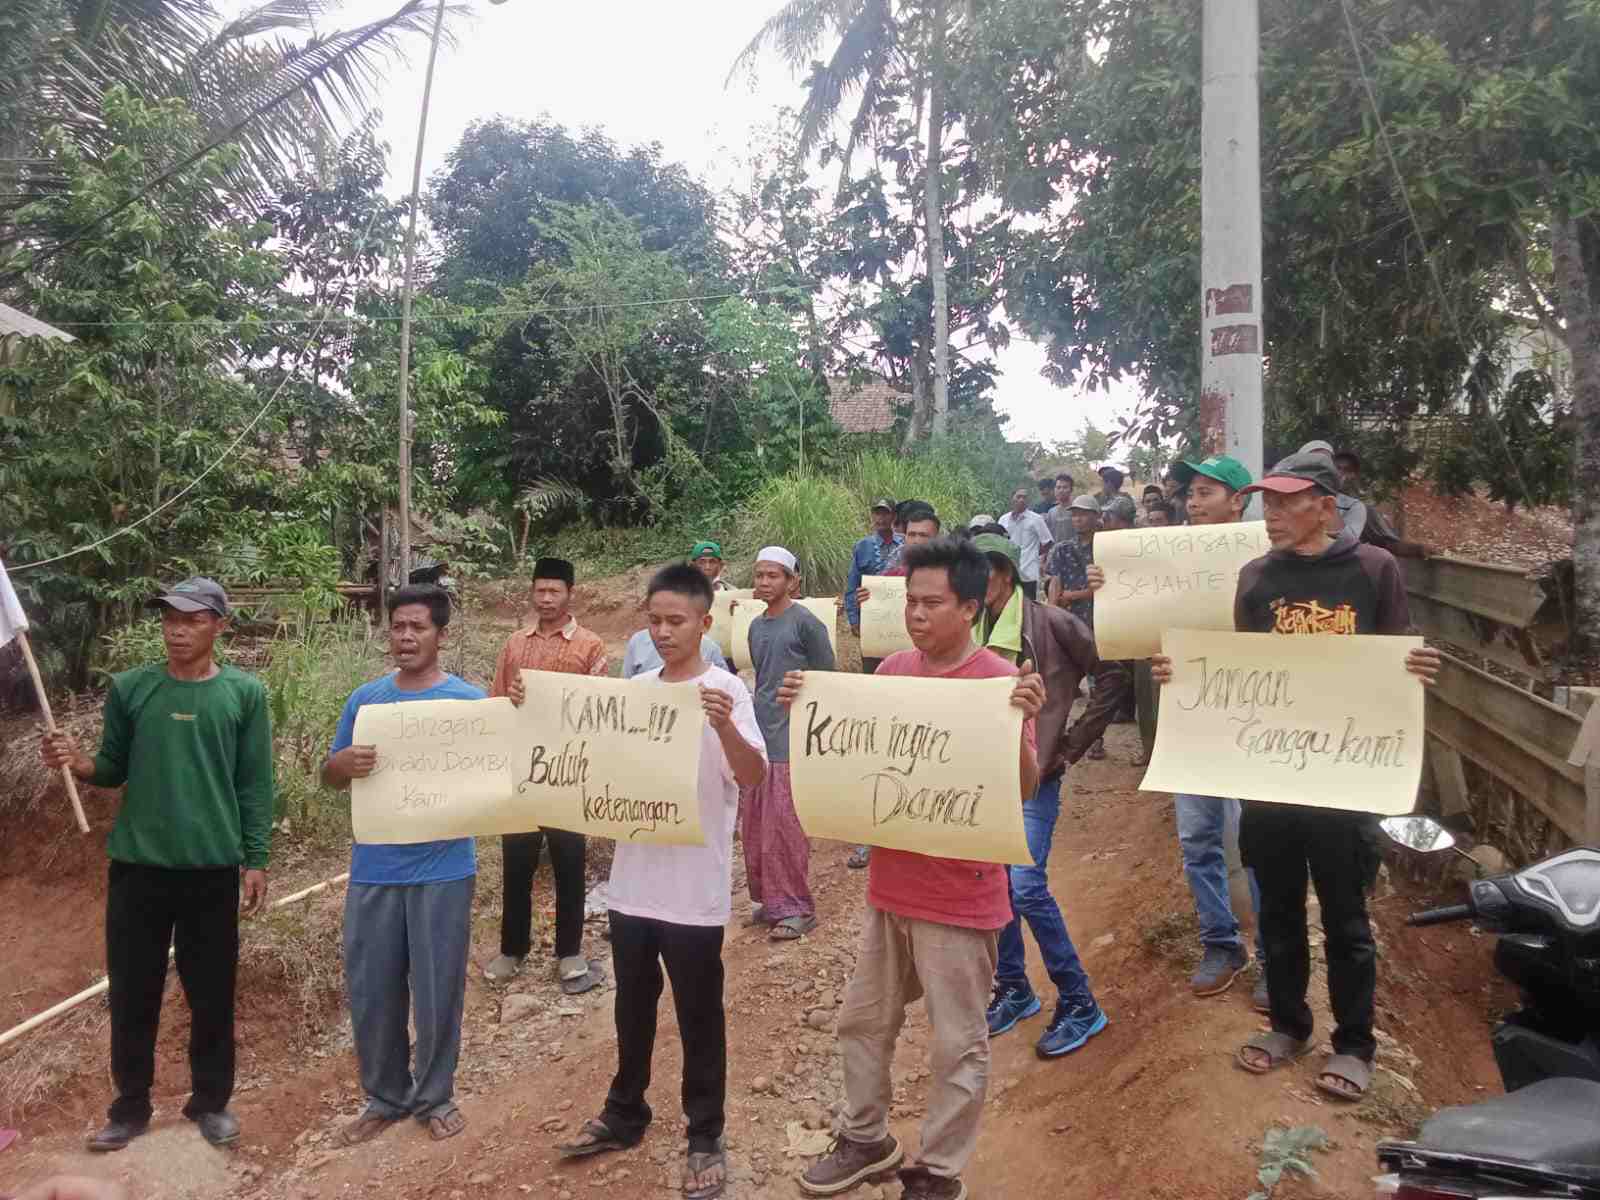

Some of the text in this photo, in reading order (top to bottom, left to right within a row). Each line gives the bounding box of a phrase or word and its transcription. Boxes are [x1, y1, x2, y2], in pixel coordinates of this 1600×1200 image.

[1177, 656, 1294, 723] Jangan
[391, 711, 497, 746] Jangan
[806, 700, 952, 776] Kami ingin
[582, 783, 686, 838] ketenangan
